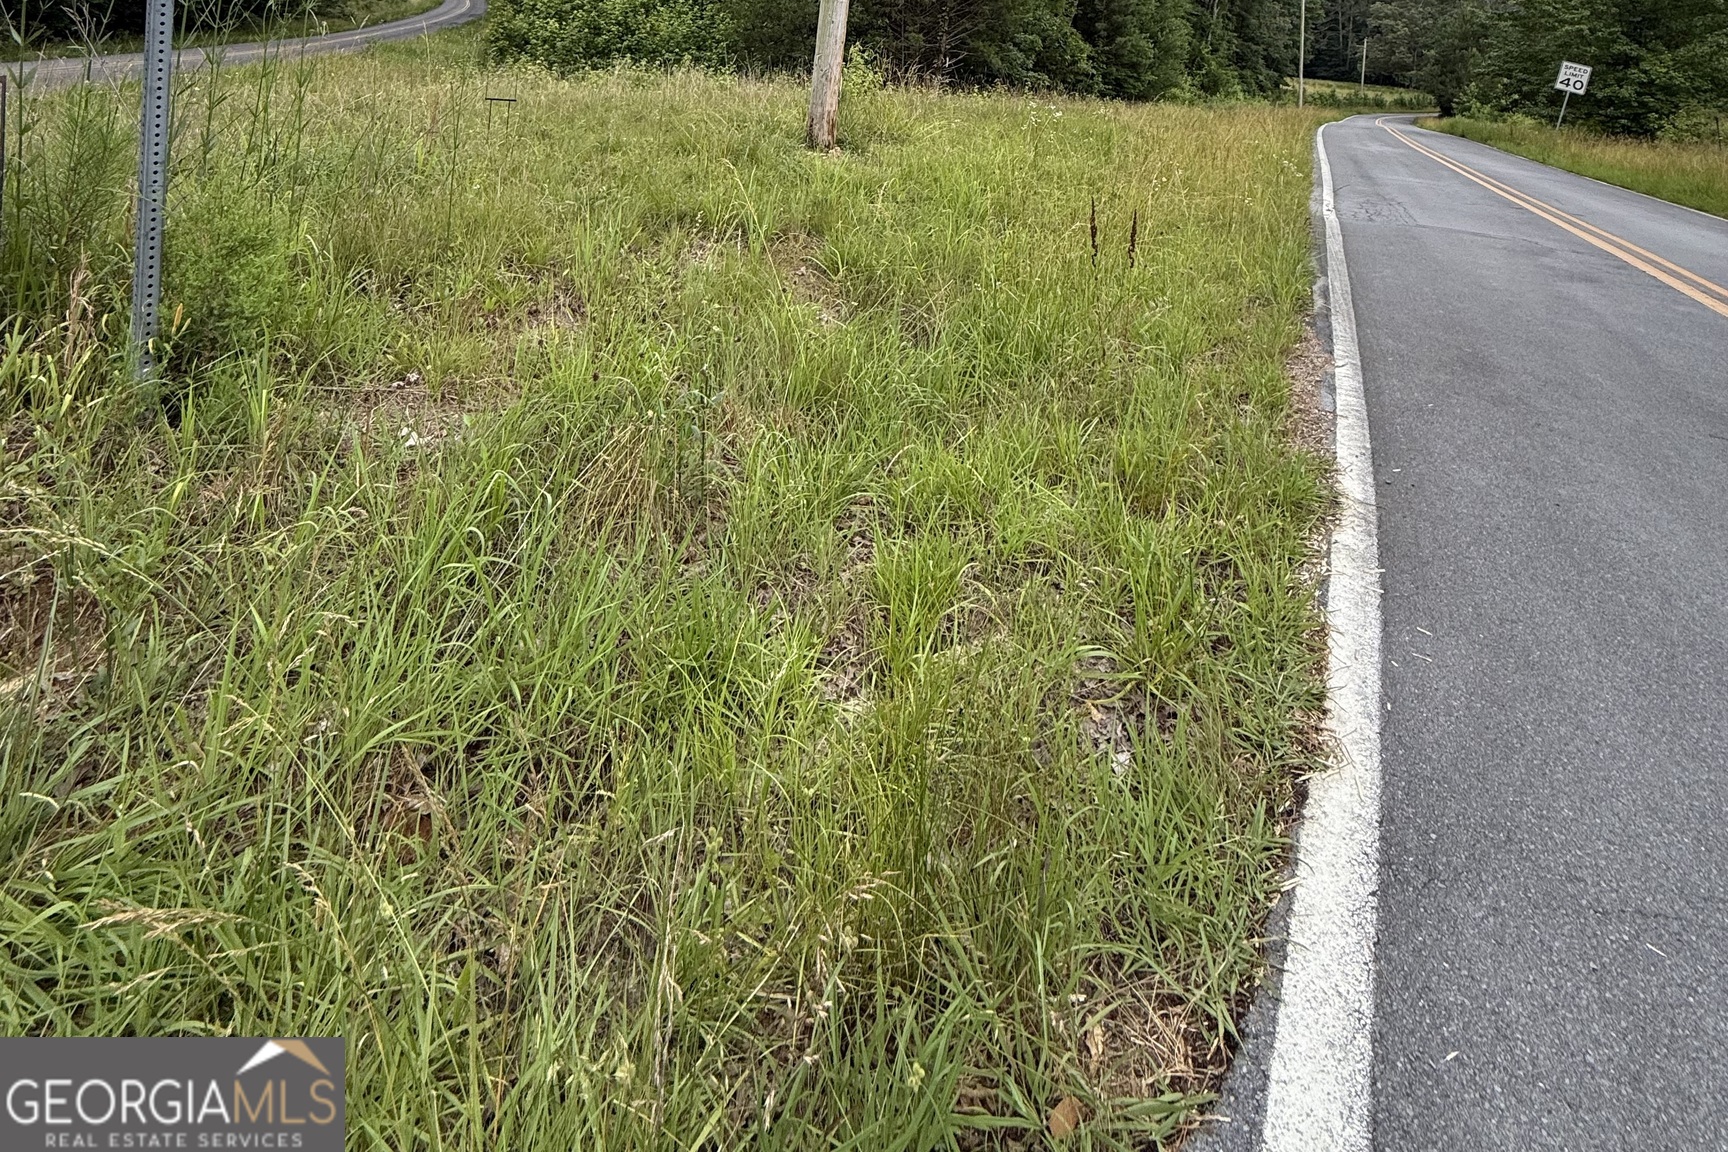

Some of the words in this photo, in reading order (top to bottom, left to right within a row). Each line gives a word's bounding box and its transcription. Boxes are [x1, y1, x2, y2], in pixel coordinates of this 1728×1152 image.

[1564, 64, 1588, 74] SPEED
[1564, 70, 1585, 79] LIMIT
[1559, 77, 1584, 91] 40
